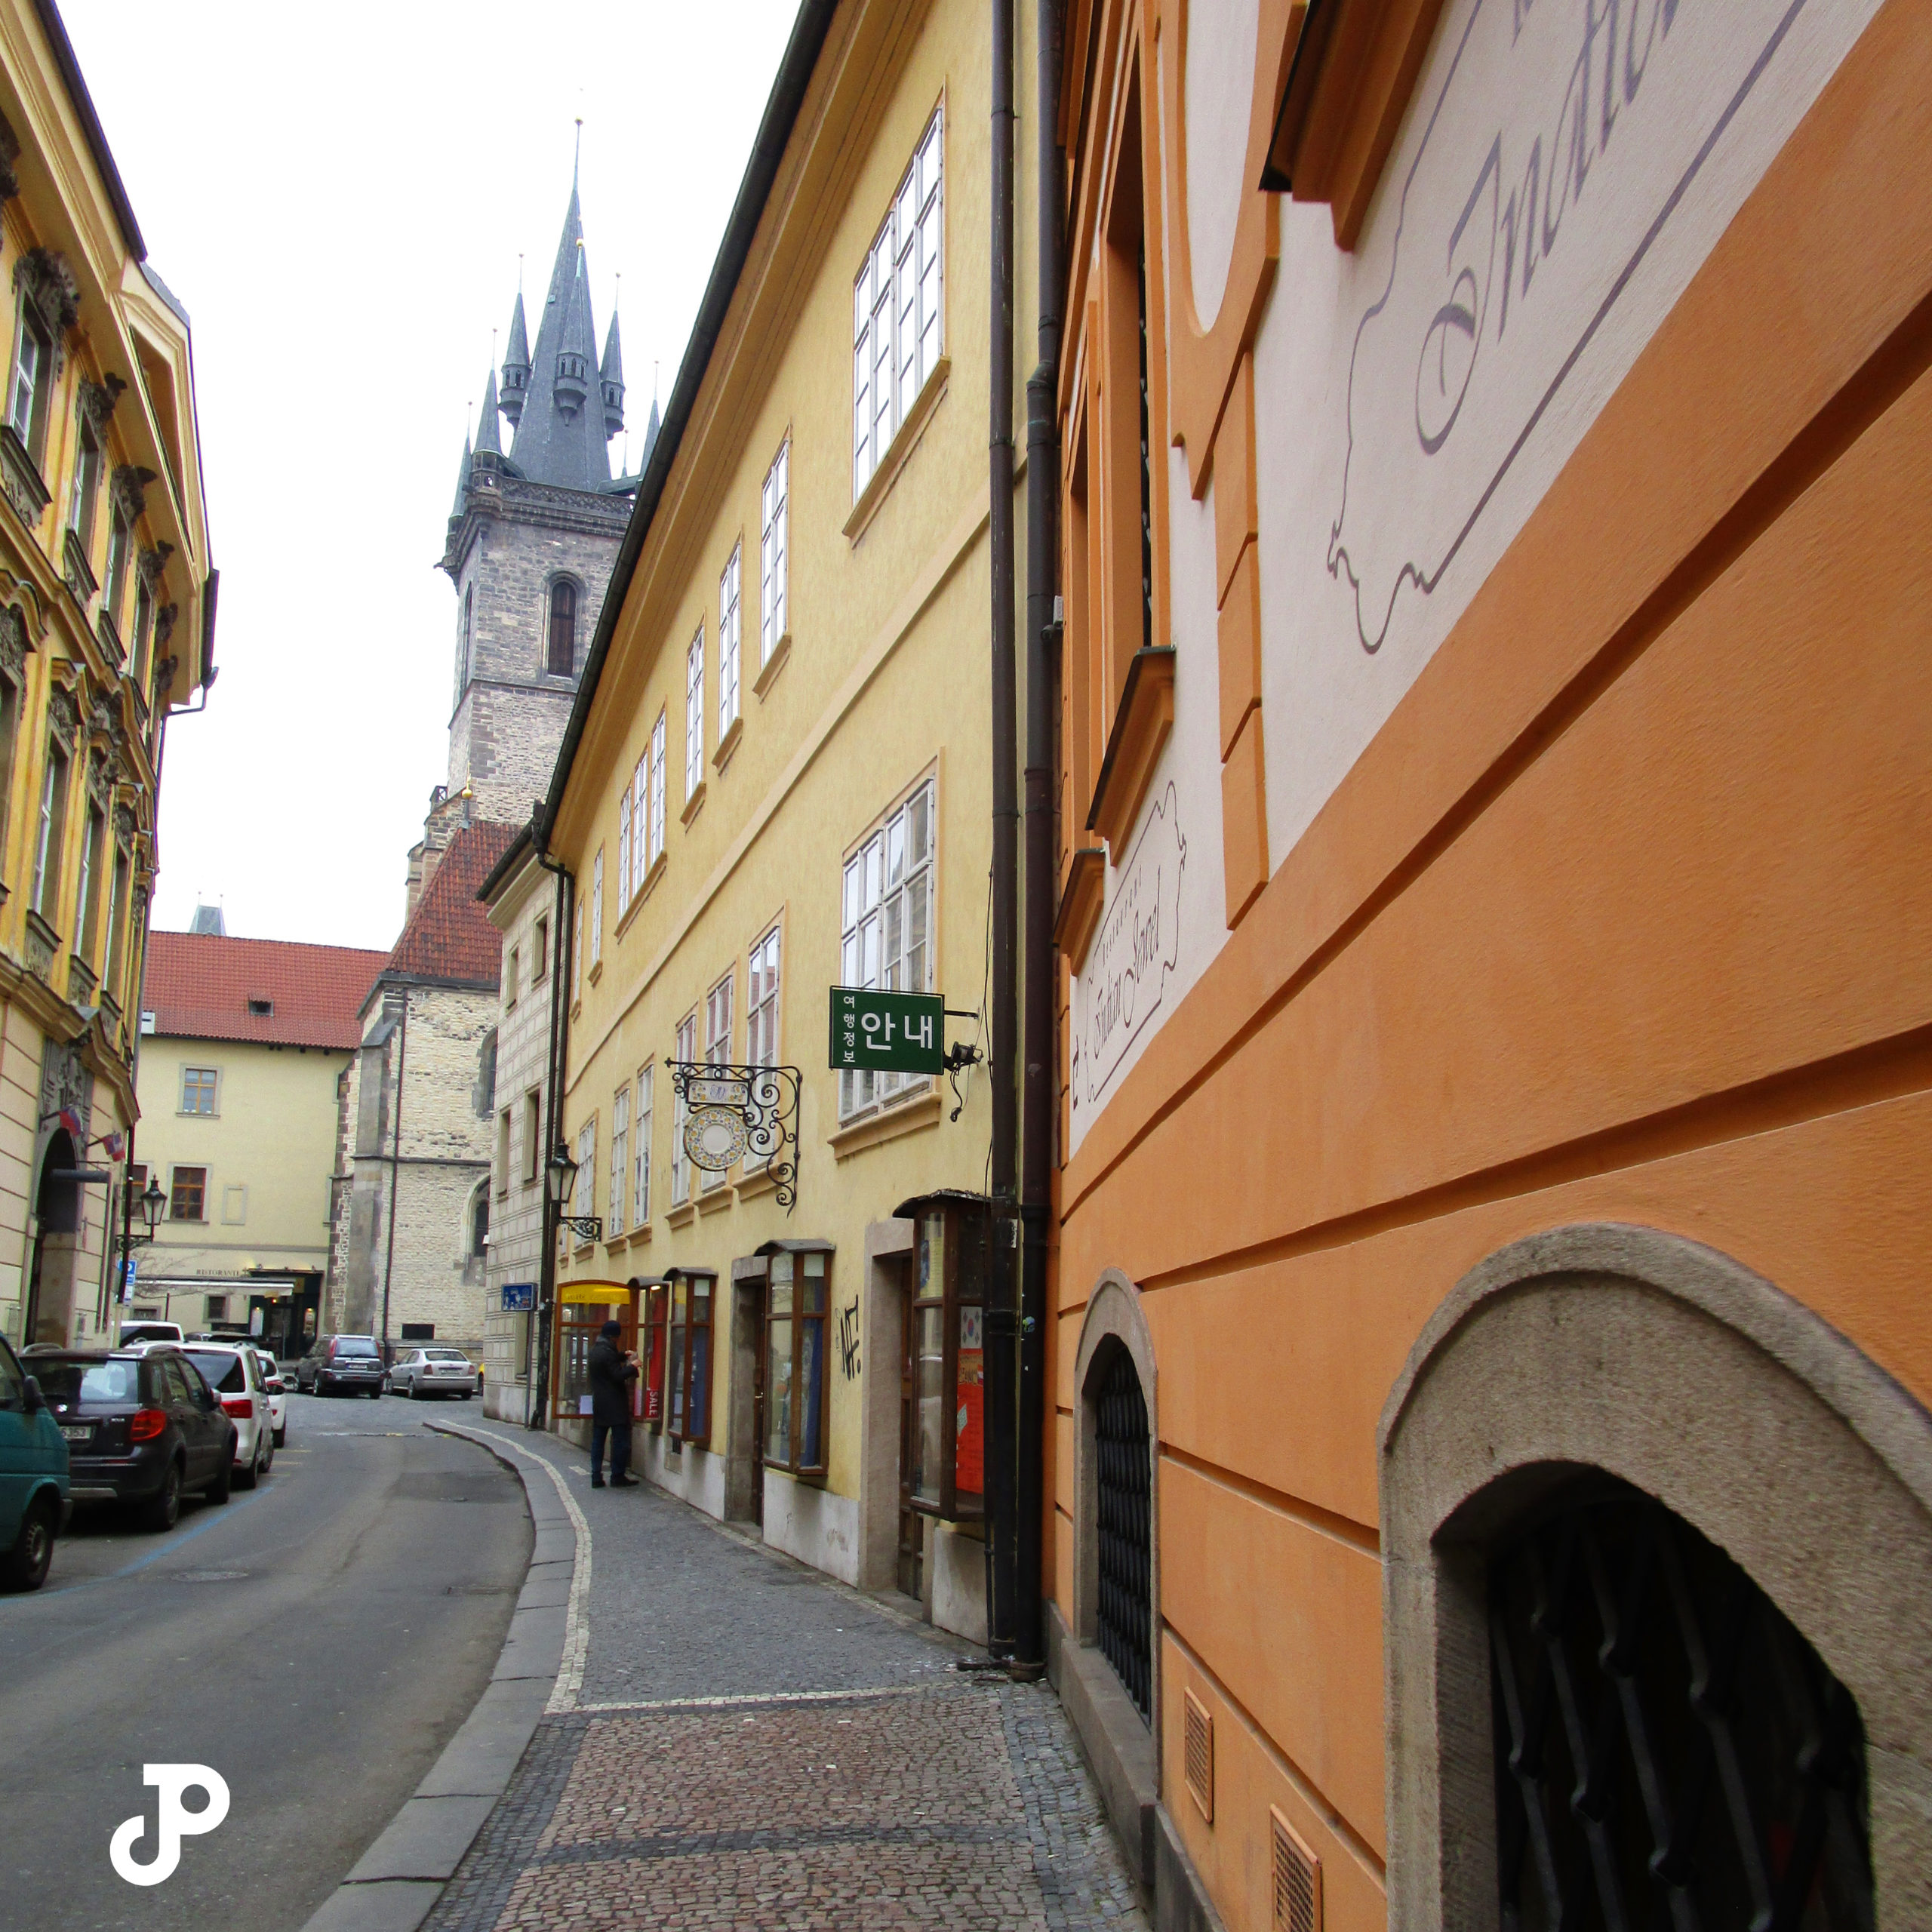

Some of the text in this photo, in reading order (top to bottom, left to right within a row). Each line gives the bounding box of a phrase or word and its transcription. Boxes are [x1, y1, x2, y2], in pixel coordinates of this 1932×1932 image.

[1094, 865, 1161, 1060] Indian Jewel
[843, 995, 855, 1063] 여행정보
[861, 1012, 933, 1051] 안내
[649, 1391, 658, 1416] SALE
